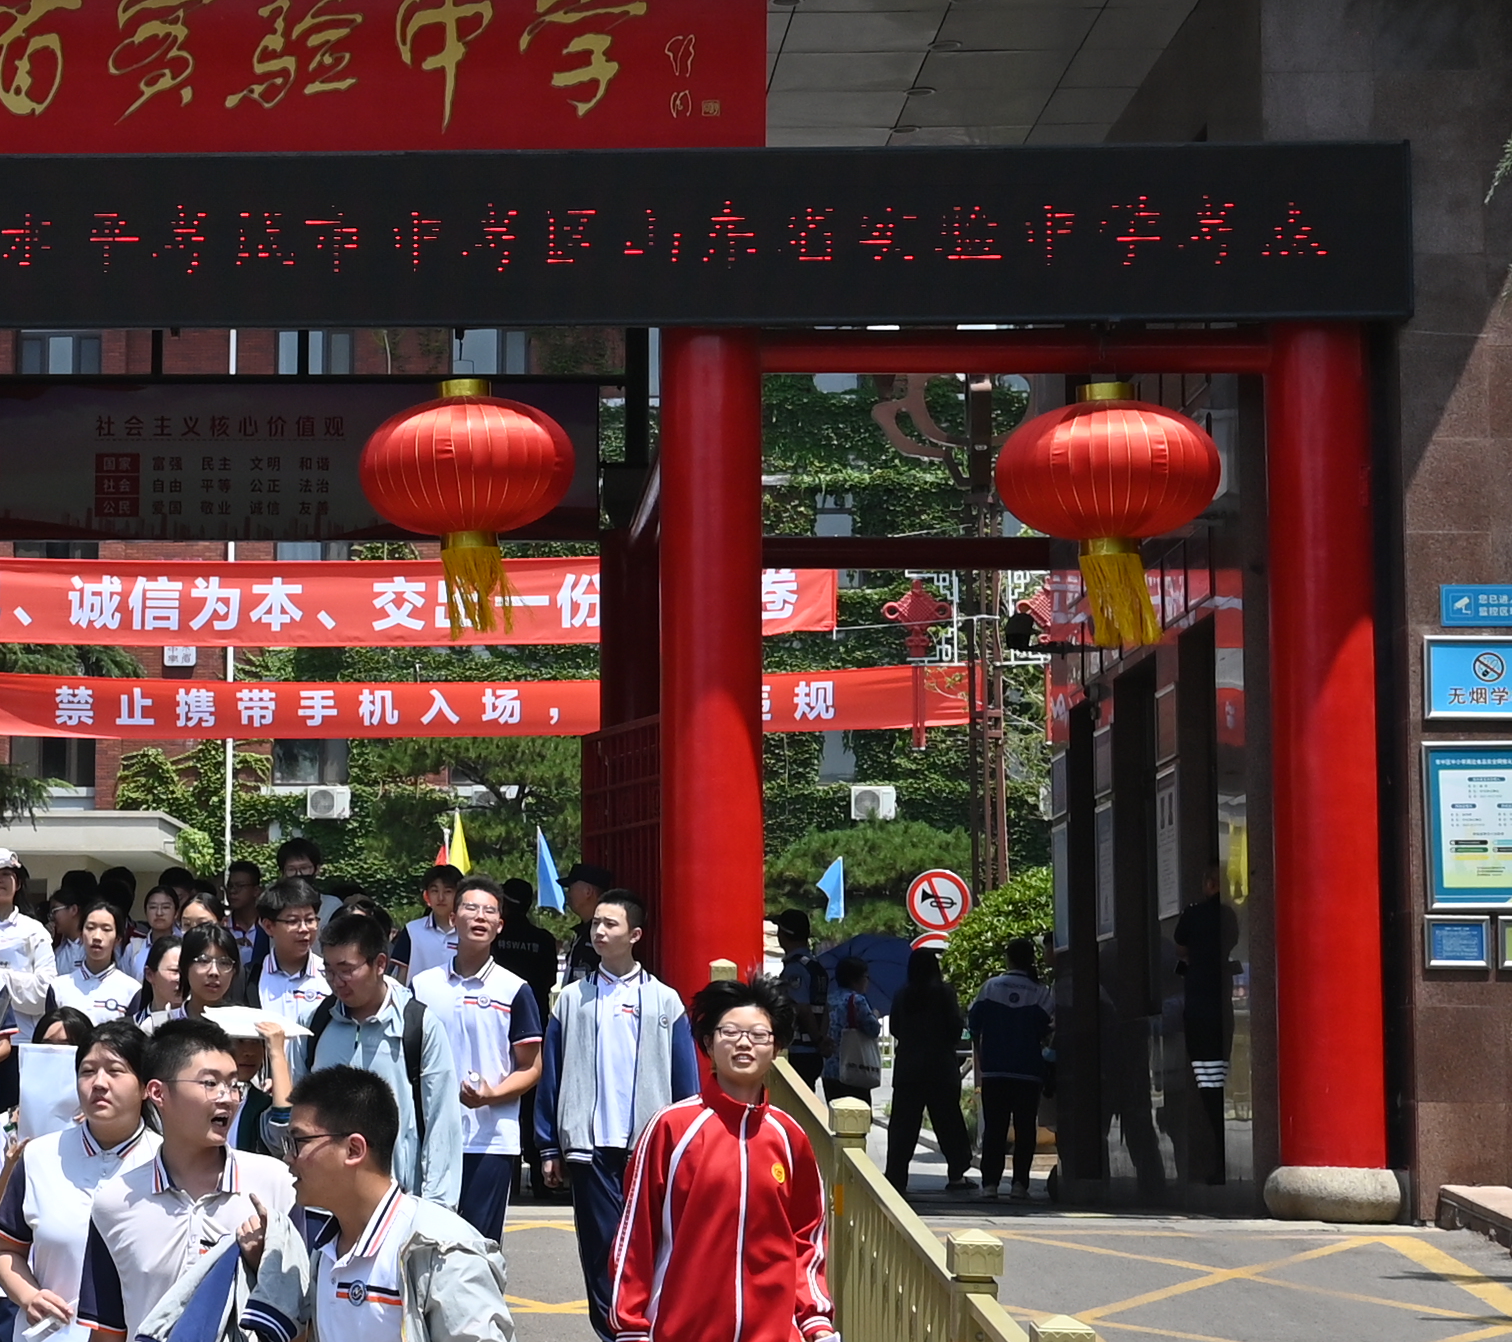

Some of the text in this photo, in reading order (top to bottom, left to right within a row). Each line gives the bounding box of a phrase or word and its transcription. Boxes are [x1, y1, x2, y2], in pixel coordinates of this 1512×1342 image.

[95, 415, 344, 438] 社会主义核心价值观
[103, 456, 330, 471] 国家 富强 民主 文明 和谐
[103, 479, 330, 493] 社会 自由 平等 公正 法治
[103, 501, 330, 515] 公民 爱国 敬业 诚信 友善
